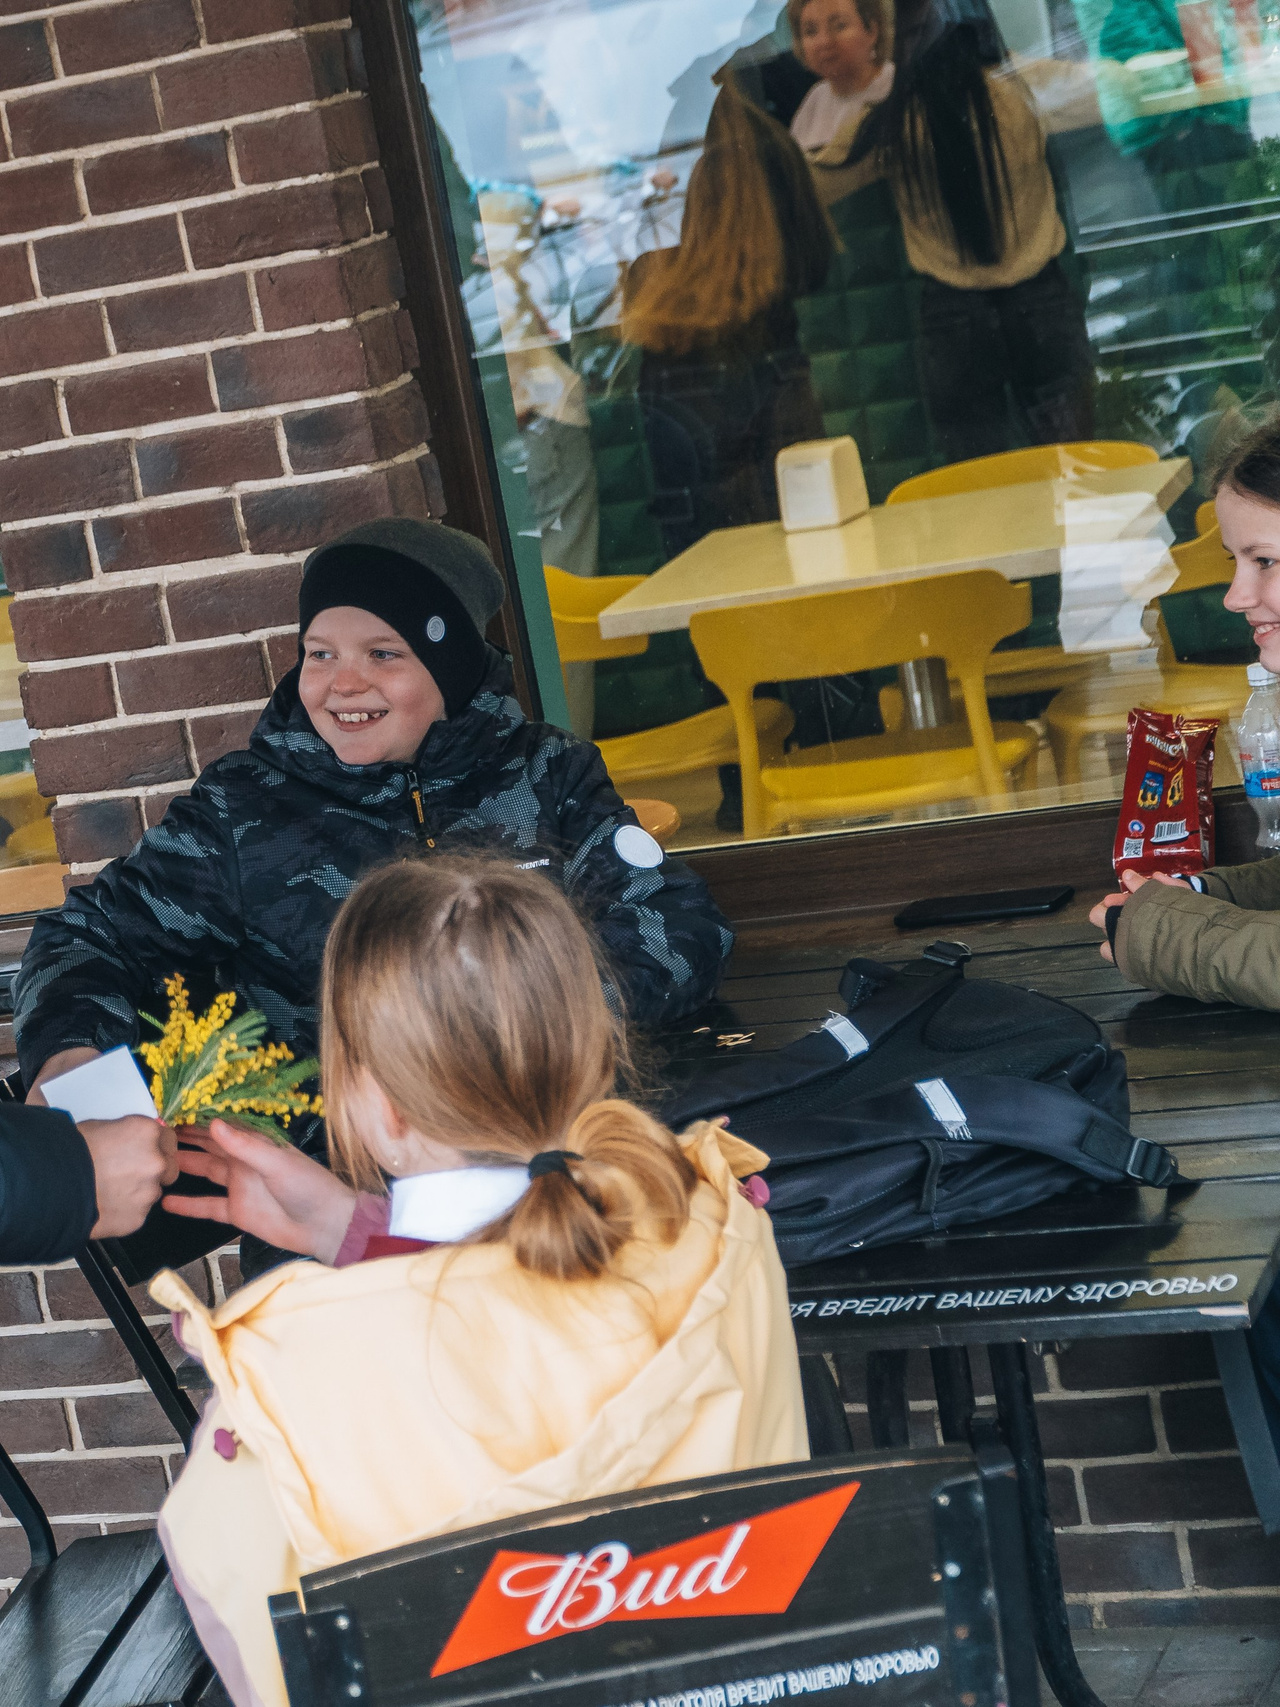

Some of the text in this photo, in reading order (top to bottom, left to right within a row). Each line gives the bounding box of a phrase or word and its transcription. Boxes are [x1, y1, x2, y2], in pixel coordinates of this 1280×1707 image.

[818, 1294, 936, 1318] ВРЕДИТ
[936, 1286, 1066, 1310] ВАШЕМУ
[1066, 1273, 1238, 1304] ЗДОРОВЬЮ
[499, 1523, 752, 1636] Bud
[726, 1673, 786, 1706] ВРЕДИТ
[786, 1662, 852, 1696] ВАШЕМУ
[852, 1645, 940, 1684] ЗДОРОВЬЮ
